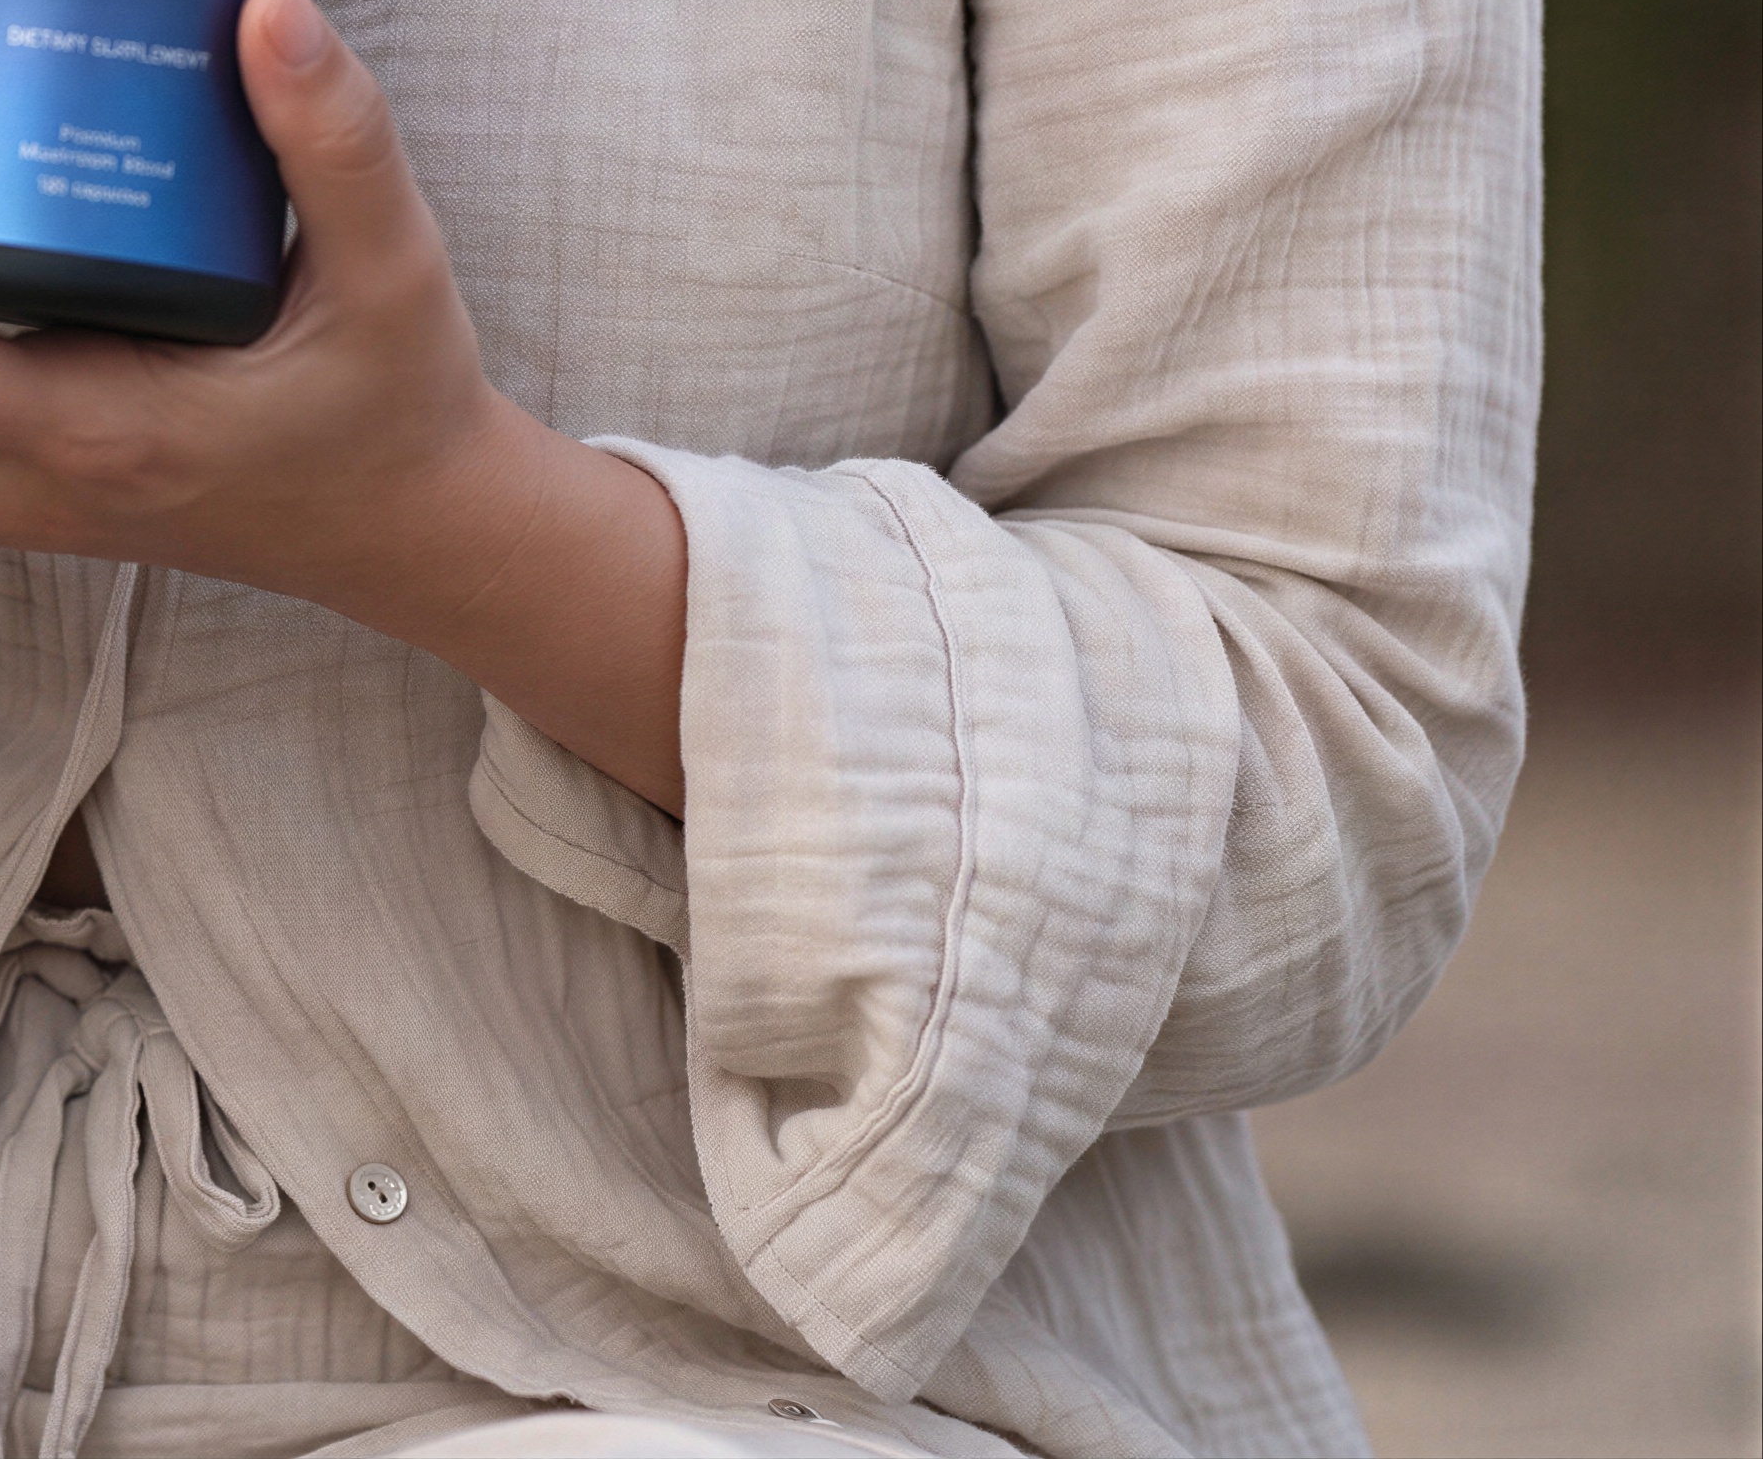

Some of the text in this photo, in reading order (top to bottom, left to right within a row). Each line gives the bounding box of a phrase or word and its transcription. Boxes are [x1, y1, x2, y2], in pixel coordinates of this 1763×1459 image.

[6, 23, 212, 71] DIETARY SUPPLEMENT
[58, 122, 142, 152] Premium
